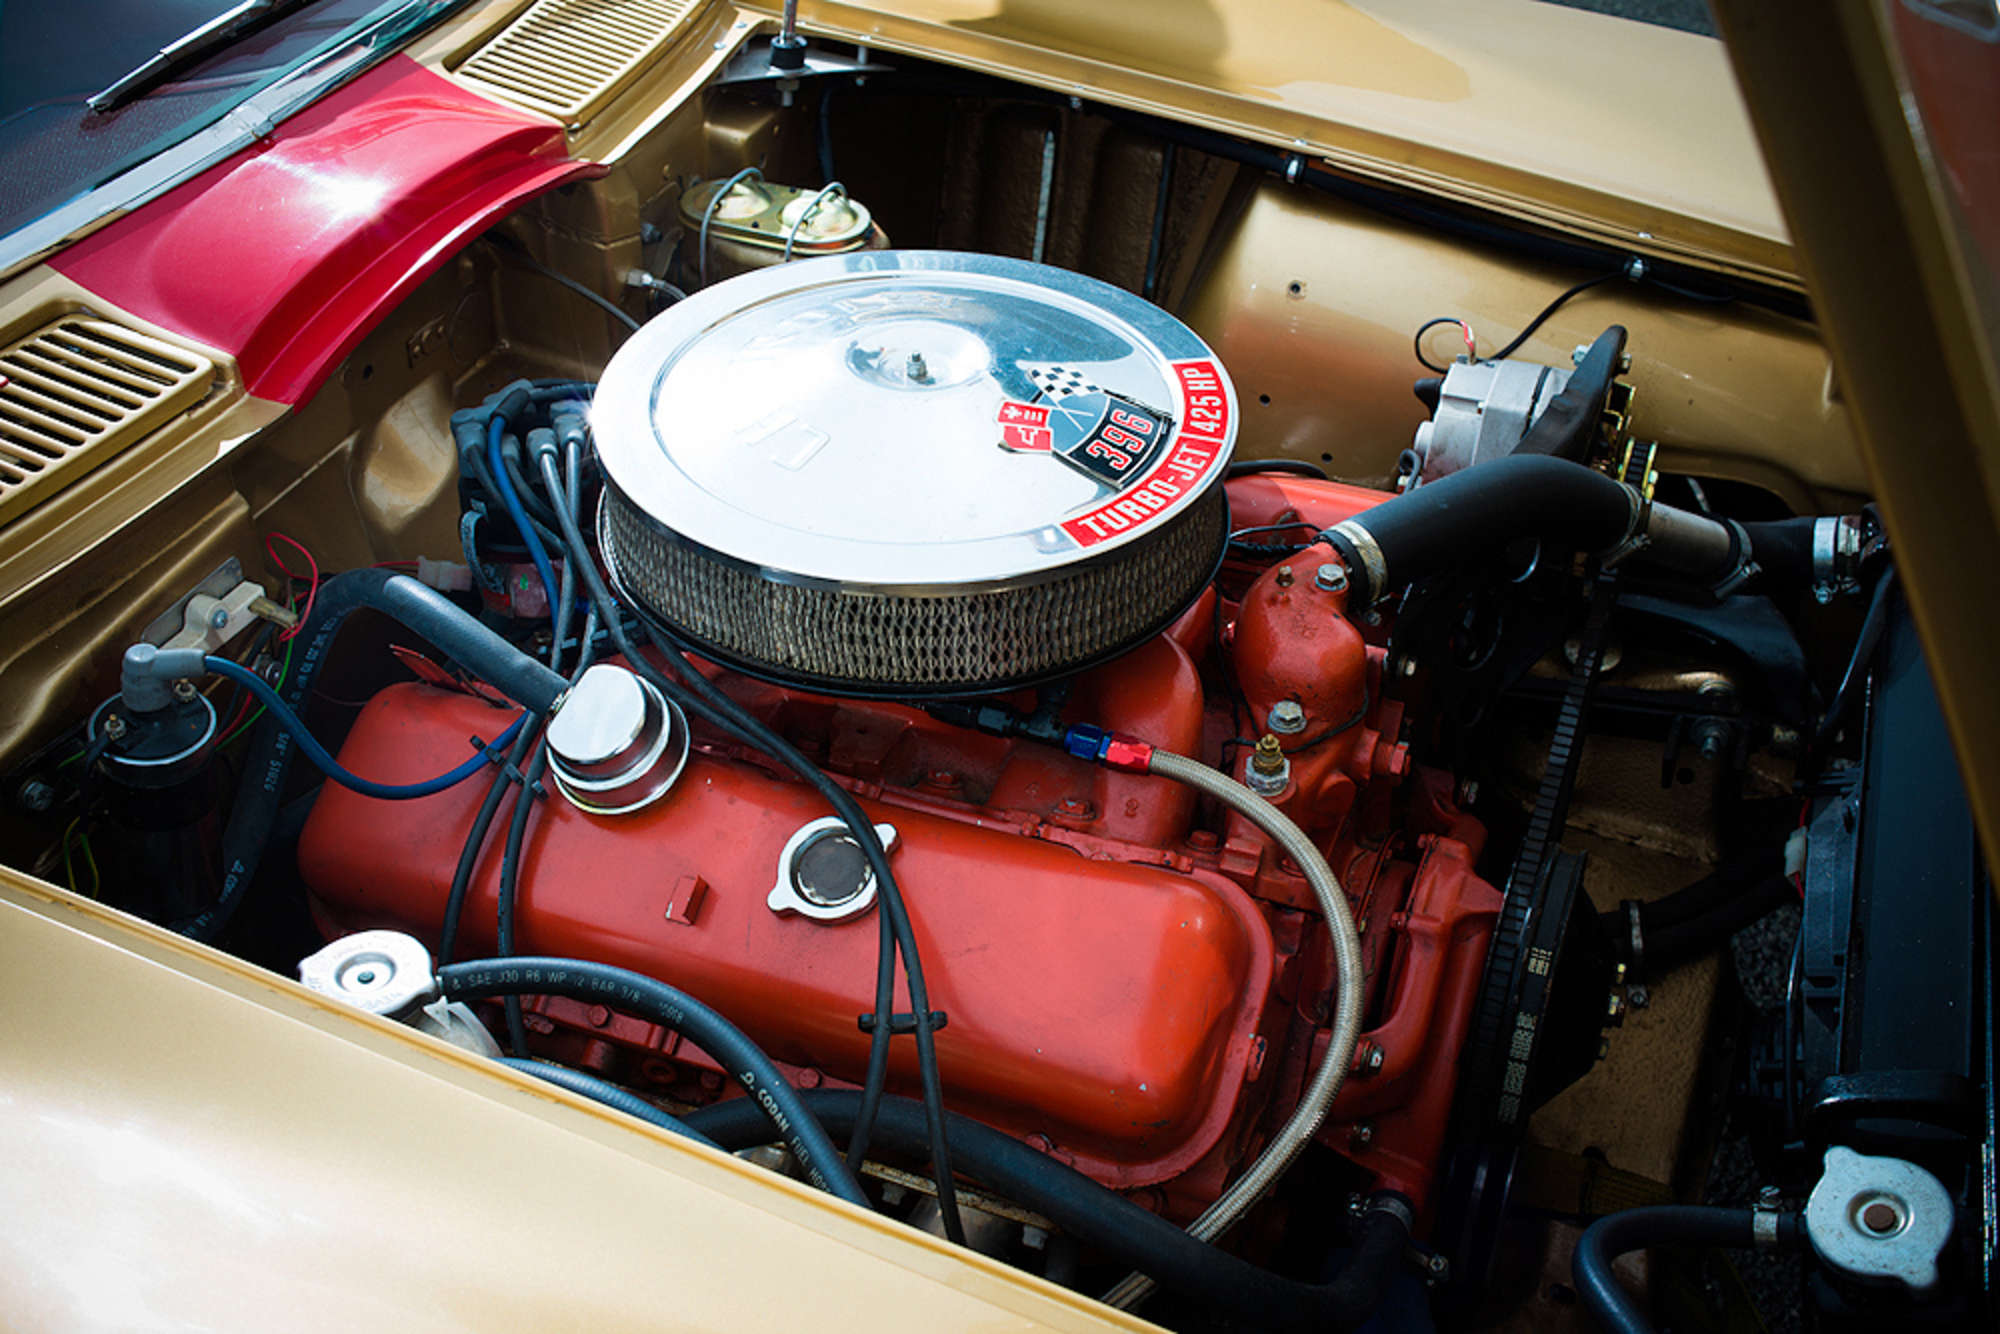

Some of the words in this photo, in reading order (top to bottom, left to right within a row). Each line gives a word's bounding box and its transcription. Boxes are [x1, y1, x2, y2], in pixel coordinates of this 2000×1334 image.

[1181, 366, 1214, 392] HP
[1190, 395, 1222, 433] 425
[1086, 408, 1154, 471] 396
[1077, 442, 1211, 537] TURBO-JET
[467, 970, 492, 987] SAE
[758, 1088, 791, 1132] CODAN
